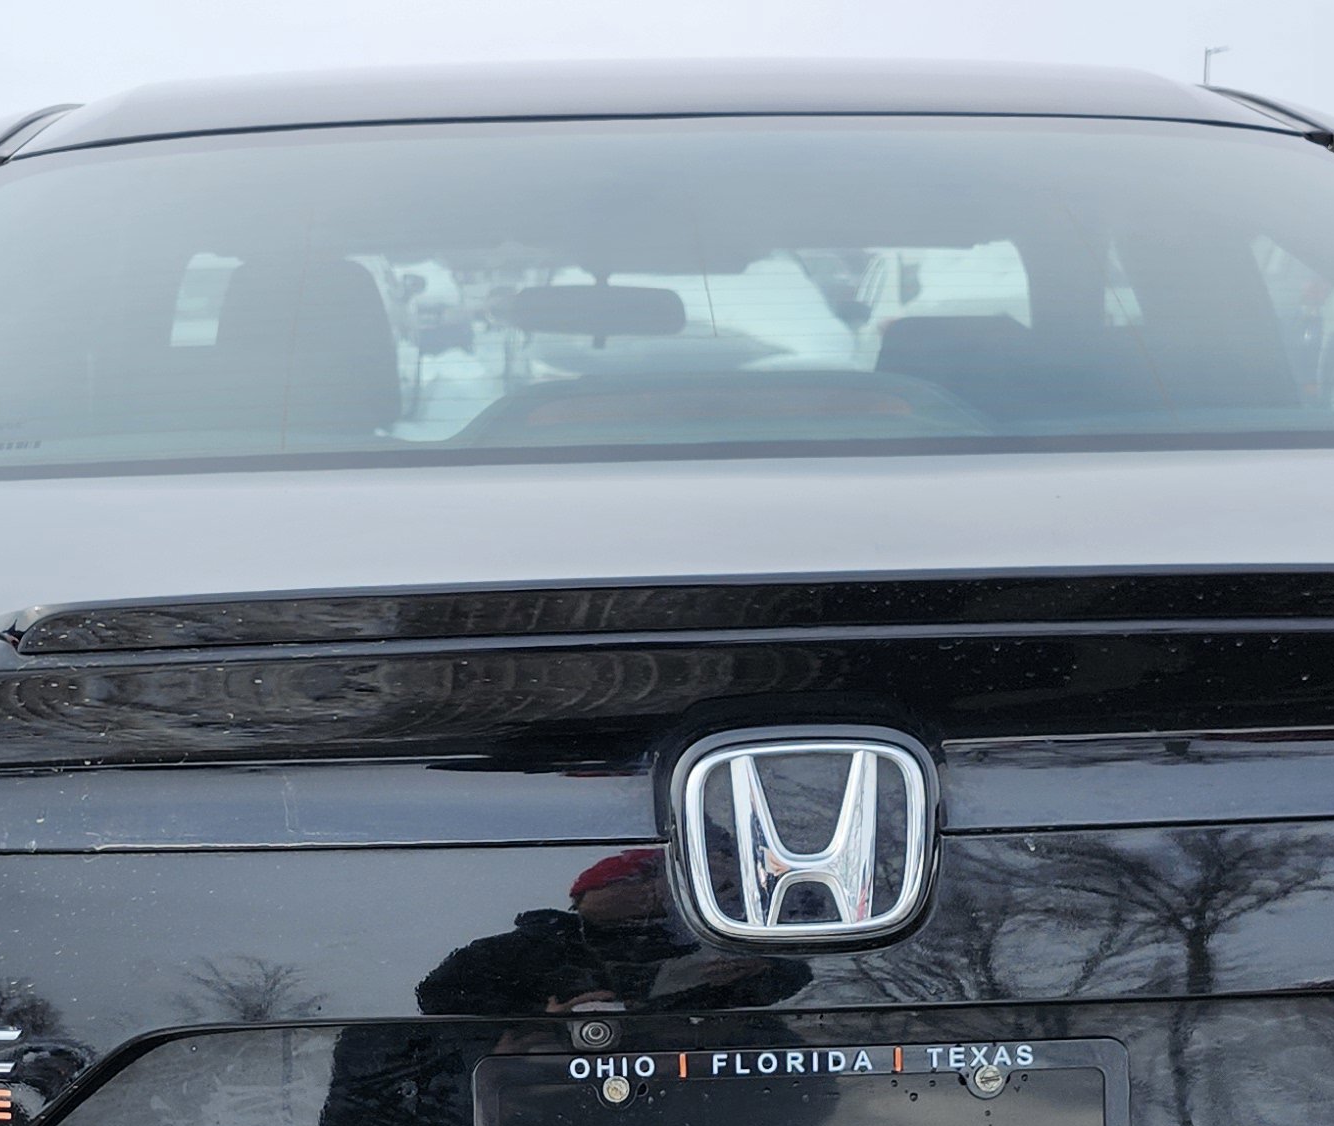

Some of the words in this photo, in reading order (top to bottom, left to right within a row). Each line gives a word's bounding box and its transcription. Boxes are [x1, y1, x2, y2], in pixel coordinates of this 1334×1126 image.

[569, 1055, 657, 1080] OHIO
[711, 1050, 873, 1075] FLORIDA
[926, 1045, 1035, 1068] TEXAS
